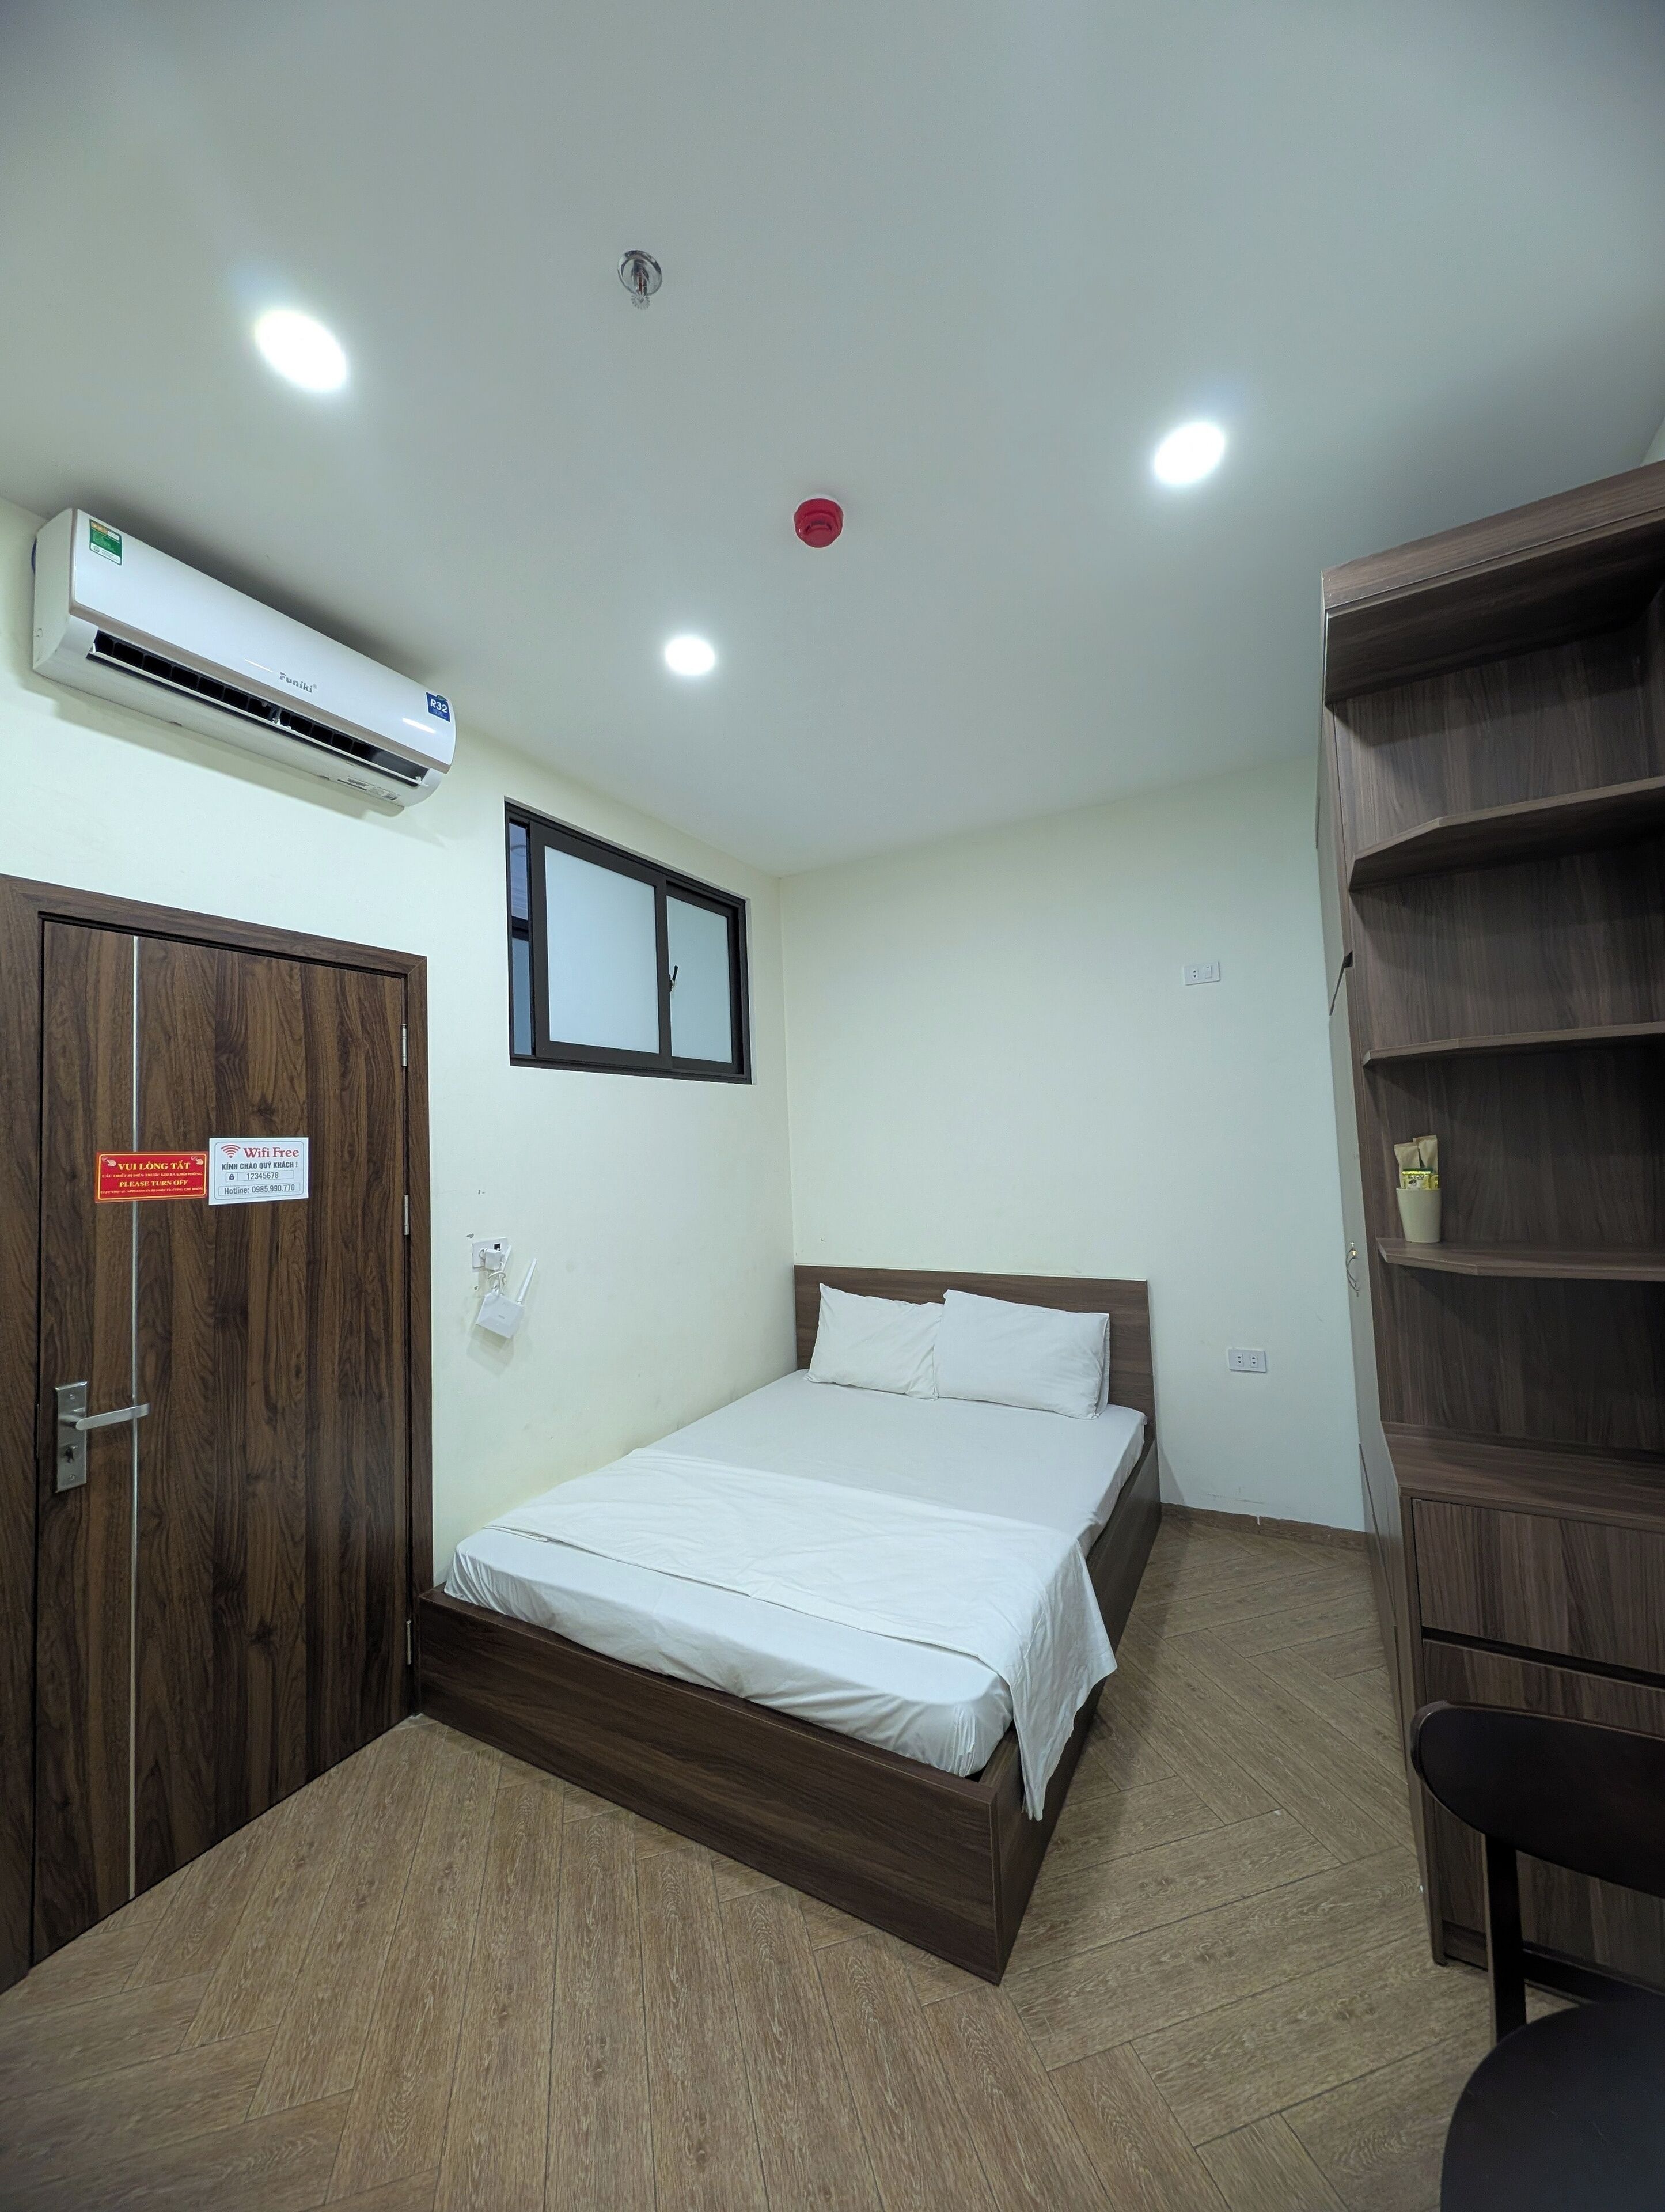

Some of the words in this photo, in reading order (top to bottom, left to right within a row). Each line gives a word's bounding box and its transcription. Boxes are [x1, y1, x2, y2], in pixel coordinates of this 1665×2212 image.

[279, 672, 313, 693] Funiki
[430, 698, 447, 714] R32
[243, 1147, 270, 1158] Wifi
[272, 1147, 299, 1157] Free
[118, 1162, 137, 1171] VUI
[139, 1161, 168, 1170] LÒNG
[170, 1160, 191, 1169] TẮT
[259, 1161, 271, 1169] QUÝ
[246, 1172, 279, 1180] 12345678
[224, 1187, 249, 1195] Hotline:
[252, 1184, 295, 1192] 0985.990.770
